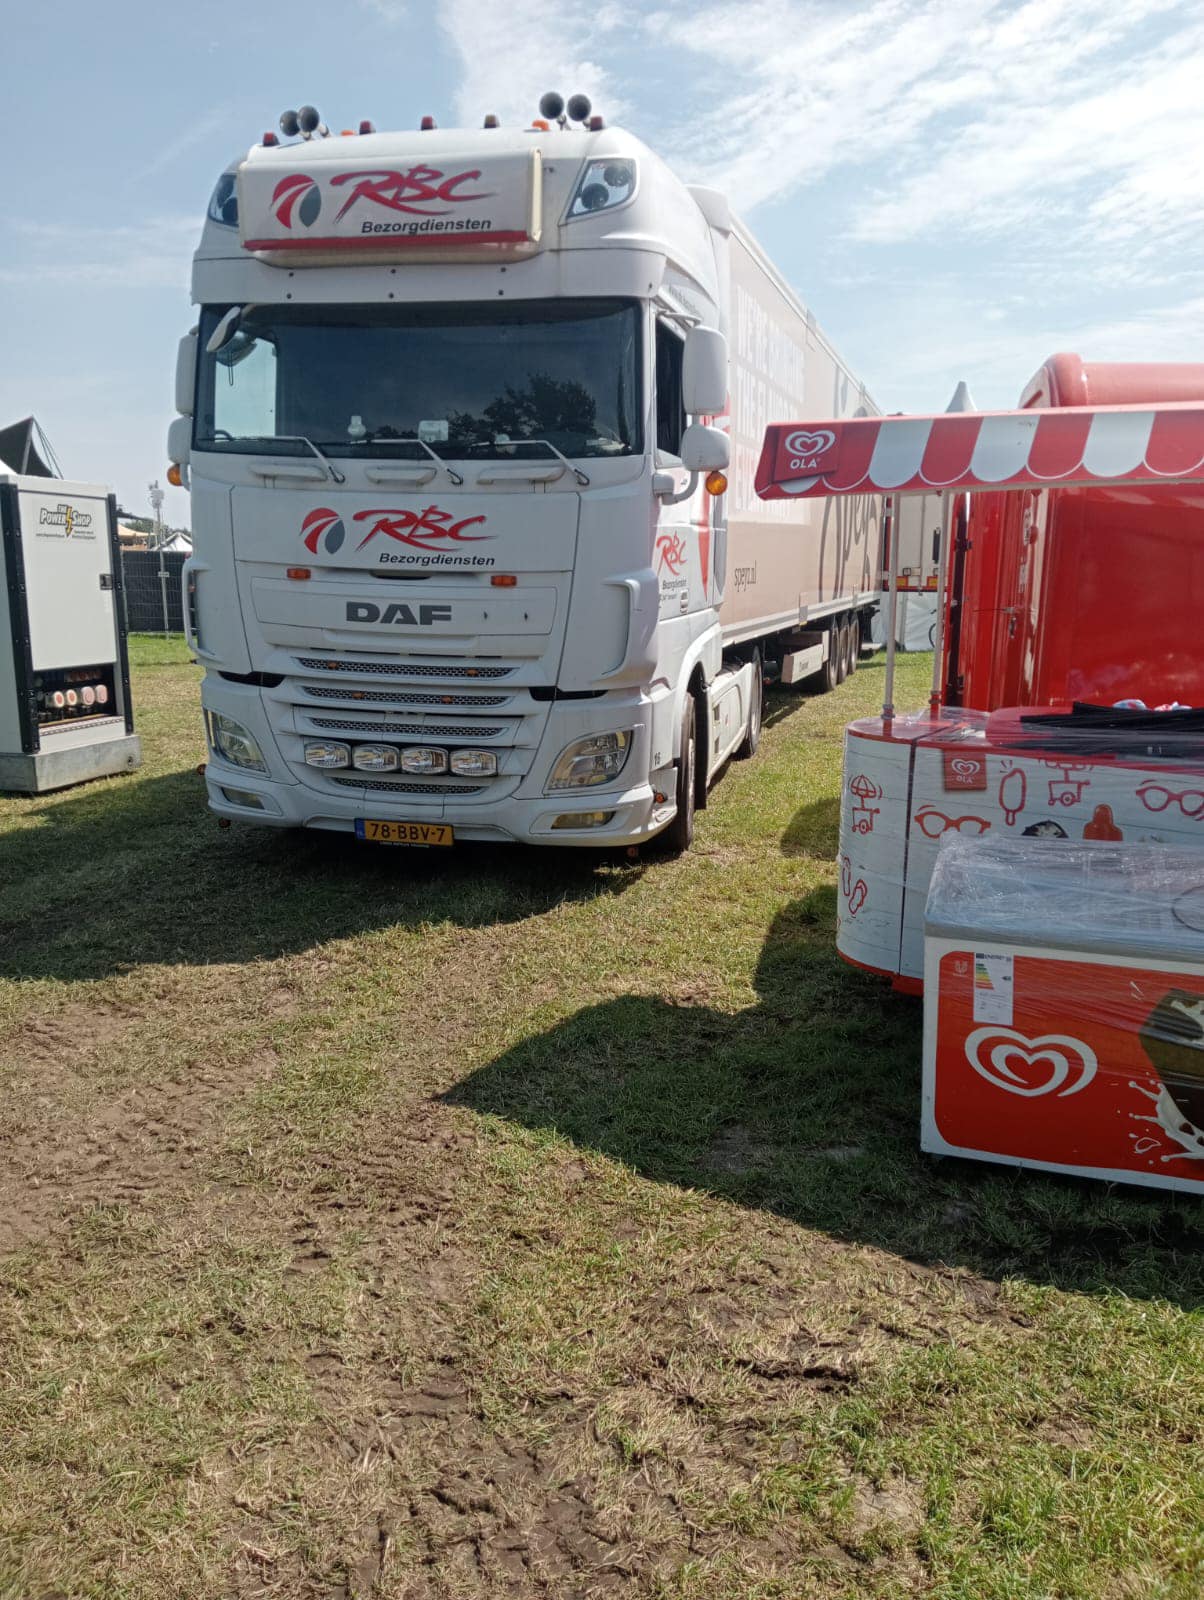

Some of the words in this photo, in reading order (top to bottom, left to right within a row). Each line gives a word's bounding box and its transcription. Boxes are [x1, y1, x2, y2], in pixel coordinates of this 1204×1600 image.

[329, 164, 496, 224] RBC
[361, 218, 492, 236] Bezorgdiensten
[790, 458, 818, 469] OLA
[352, 505, 498, 552] RBC
[379, 552, 496, 567] Bezorgdiensten
[346, 601, 452, 626] DAF
[370, 822, 445, 842] 78-BBV-7
